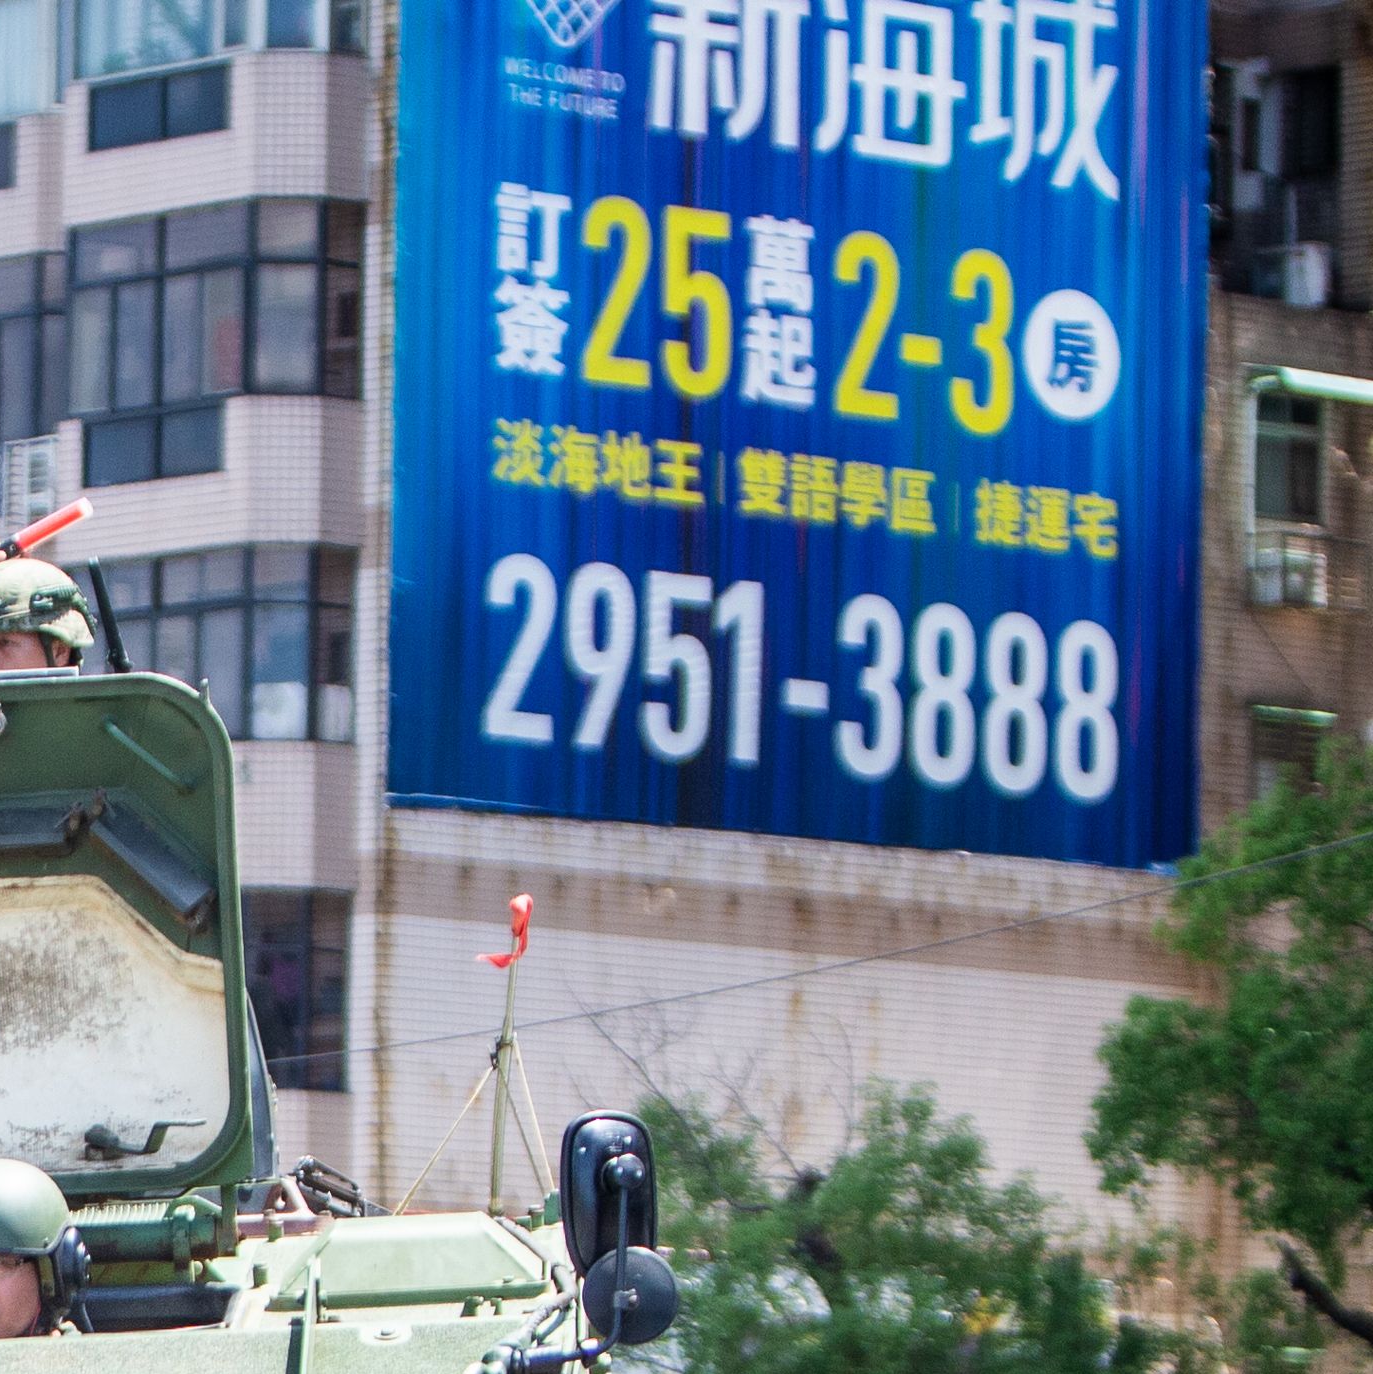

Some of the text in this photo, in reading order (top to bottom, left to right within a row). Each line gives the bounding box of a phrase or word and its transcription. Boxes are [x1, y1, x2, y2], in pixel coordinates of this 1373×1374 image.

[504, 57, 626, 92] WELCOME TO
[508, 82, 619, 119] THE FUTURE
[648, 0, 1120, 200] 新海城
[493, 180, 1099, 437] 訂簽 25 萬起 2-3 房
[490, 417, 1119, 560] 淡海地王 雙語學區 捷運宅
[482, 552, 1120, 803] 2951-3888
